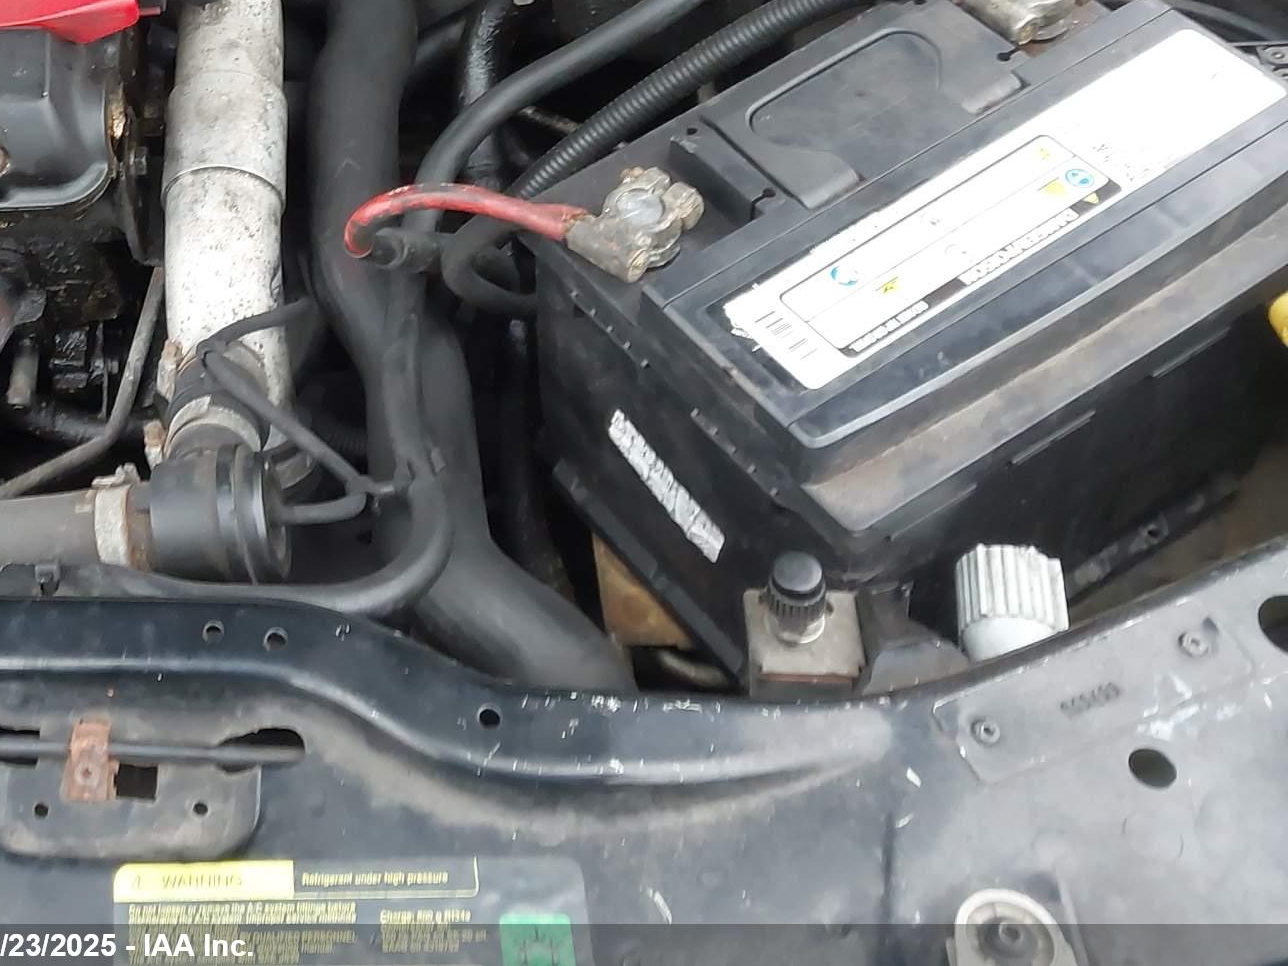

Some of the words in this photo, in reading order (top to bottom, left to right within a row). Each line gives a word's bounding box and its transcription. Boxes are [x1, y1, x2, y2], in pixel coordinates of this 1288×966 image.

[162, 873, 243, 889] WARNING
[355, 872, 381, 885] under
[384, 871, 405, 886] high
[407, 870, 448, 886] pressure
